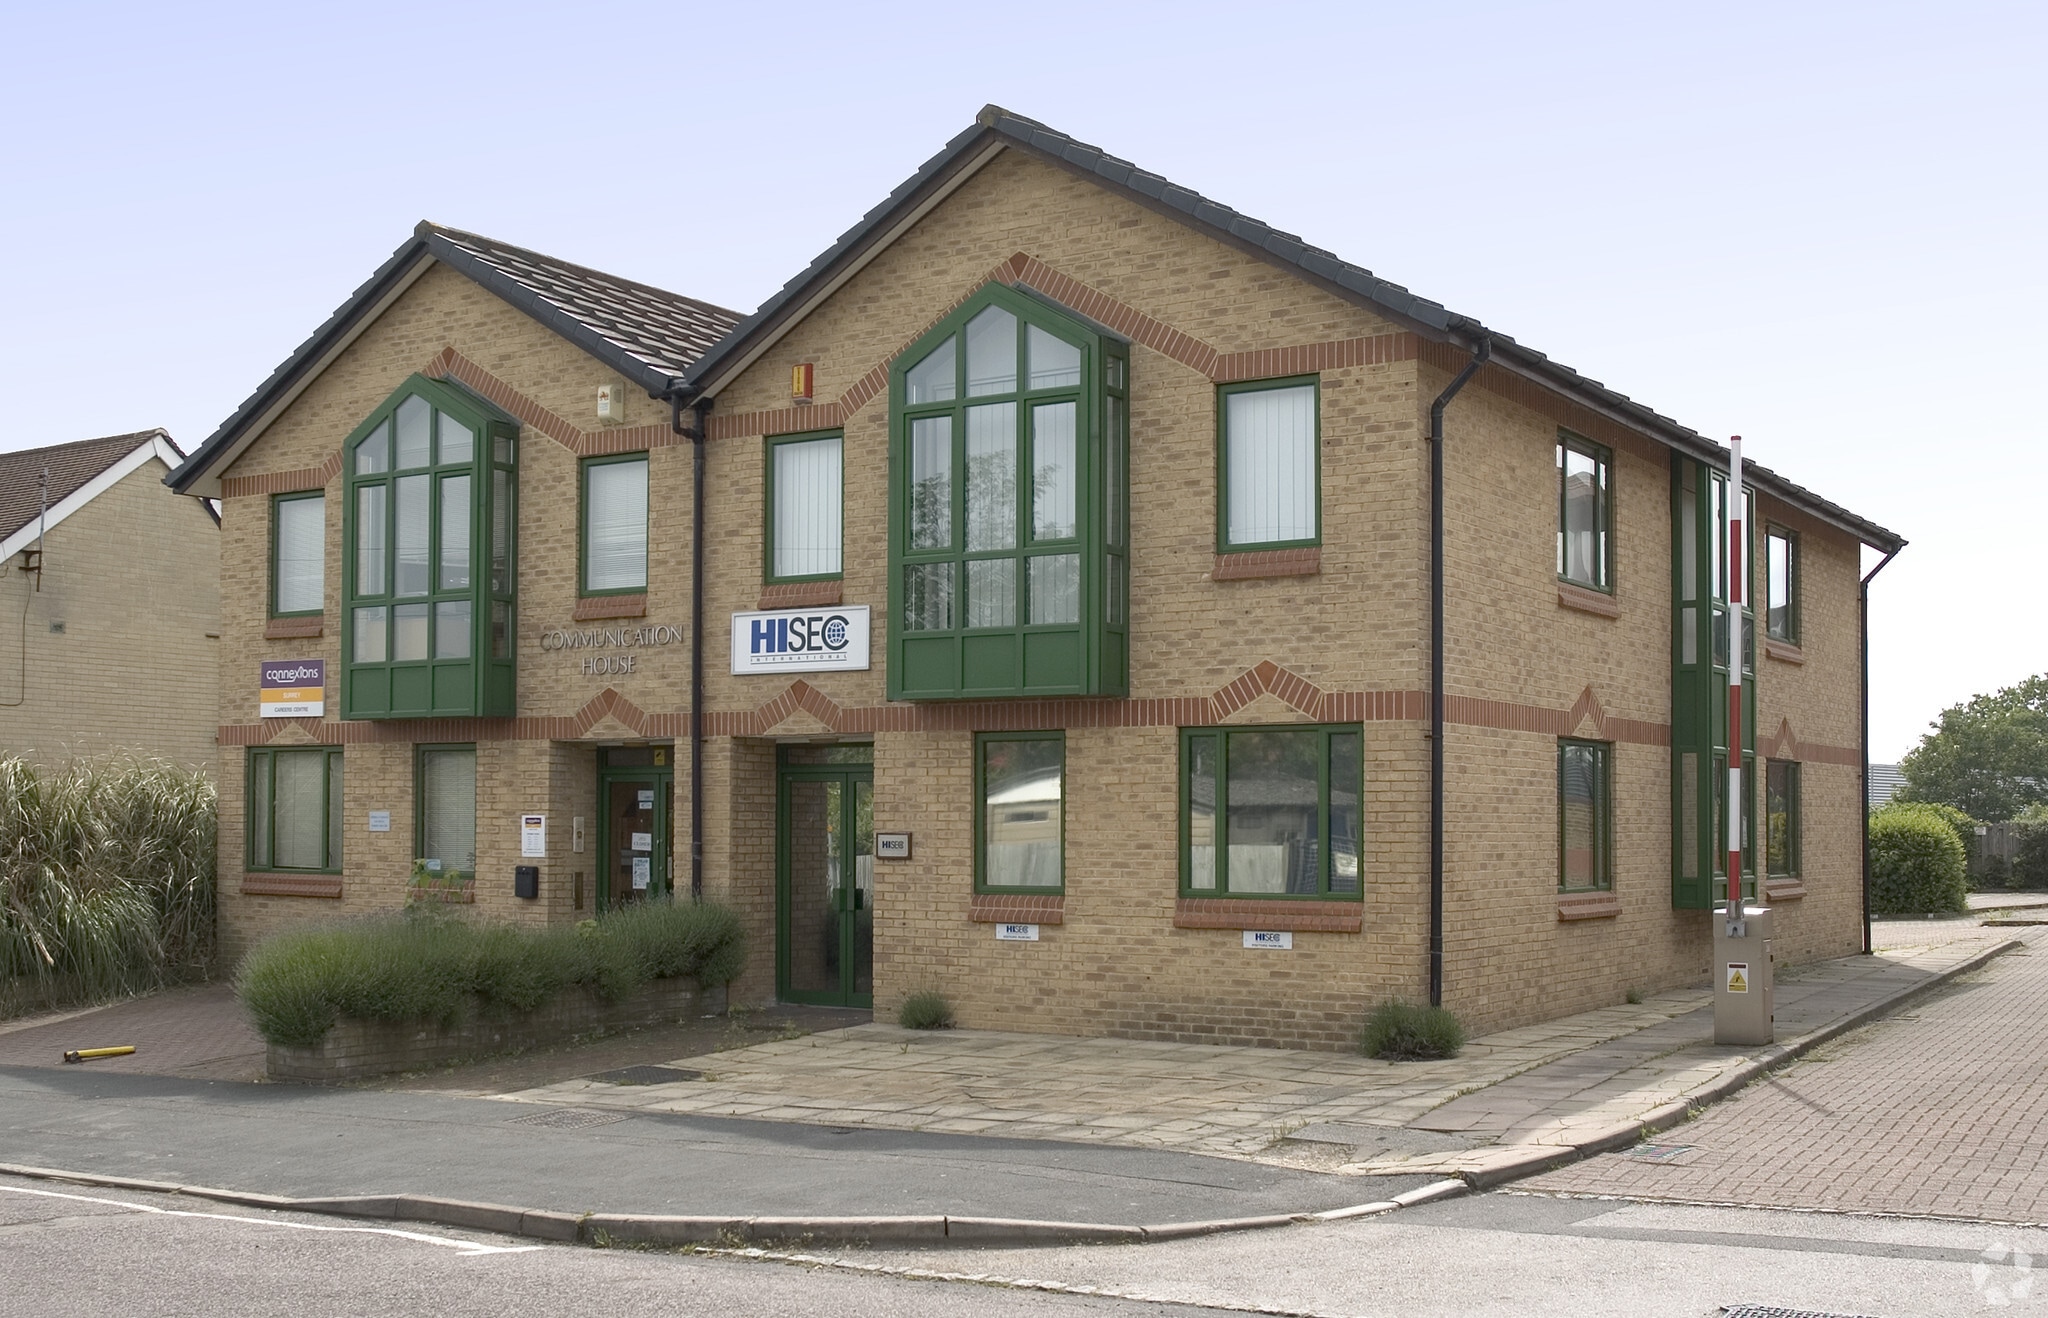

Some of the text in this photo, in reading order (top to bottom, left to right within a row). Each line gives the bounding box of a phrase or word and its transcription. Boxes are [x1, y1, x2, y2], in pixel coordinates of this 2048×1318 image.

[540, 625, 684, 651] COMMUNICATION
[751, 615, 850, 654] HISEC
[750, 654, 848, 662] INTERNATIONAL
[582, 655, 637, 675] HOUSE
[266, 666, 319, 683] connexions
[882, 840, 904, 850] HISEC
[1006, 925, 1029, 933] HISEC
[1255, 933, 1280, 942] HISEC
